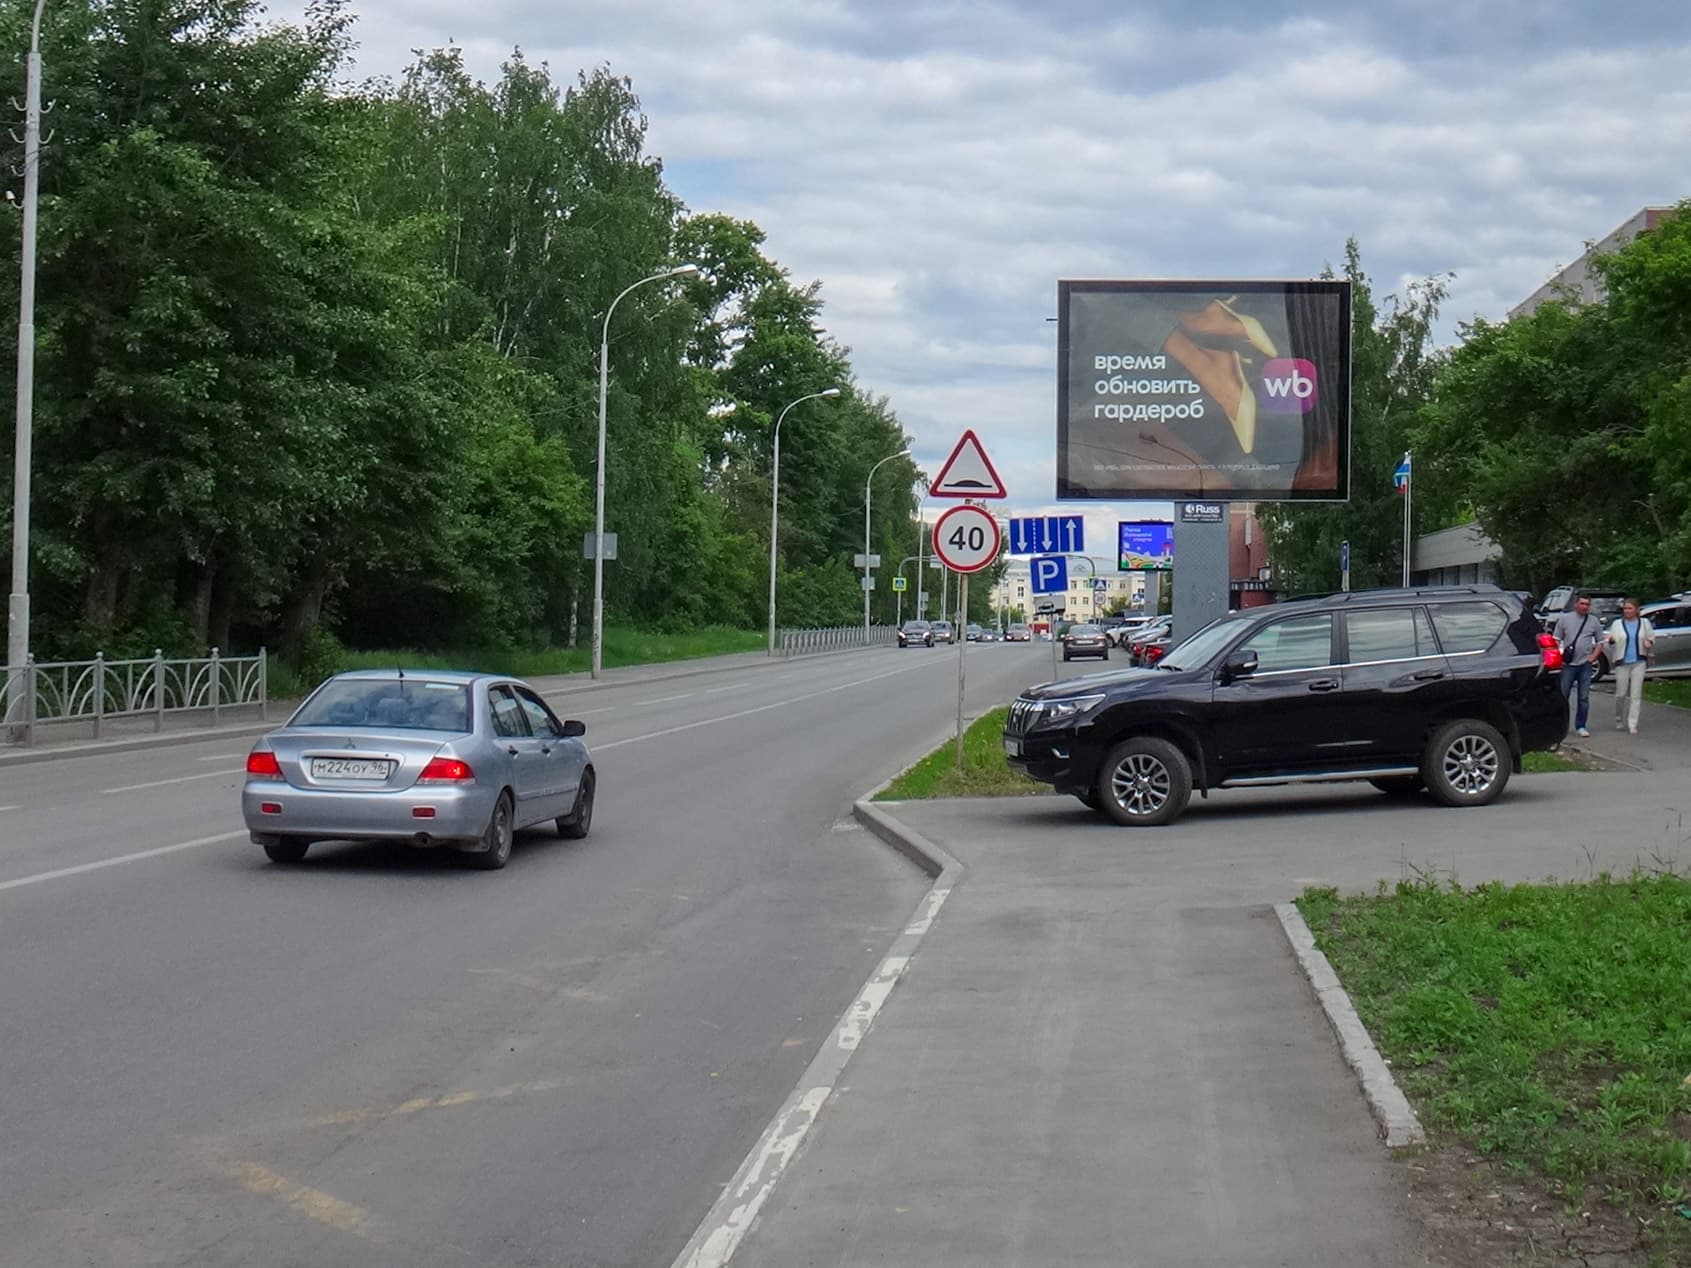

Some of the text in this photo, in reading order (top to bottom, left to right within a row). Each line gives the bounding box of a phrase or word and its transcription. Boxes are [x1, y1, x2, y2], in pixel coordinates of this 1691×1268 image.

[1094, 353, 1166, 374] время
[1094, 374, 1201, 395] обновить
[1264, 370, 1314, 398] wb
[1094, 399, 1205, 423] гардероб
[1195, 504, 1220, 514] Russ
[948, 526, 985, 551] 40
[1038, 560, 1060, 590] P
